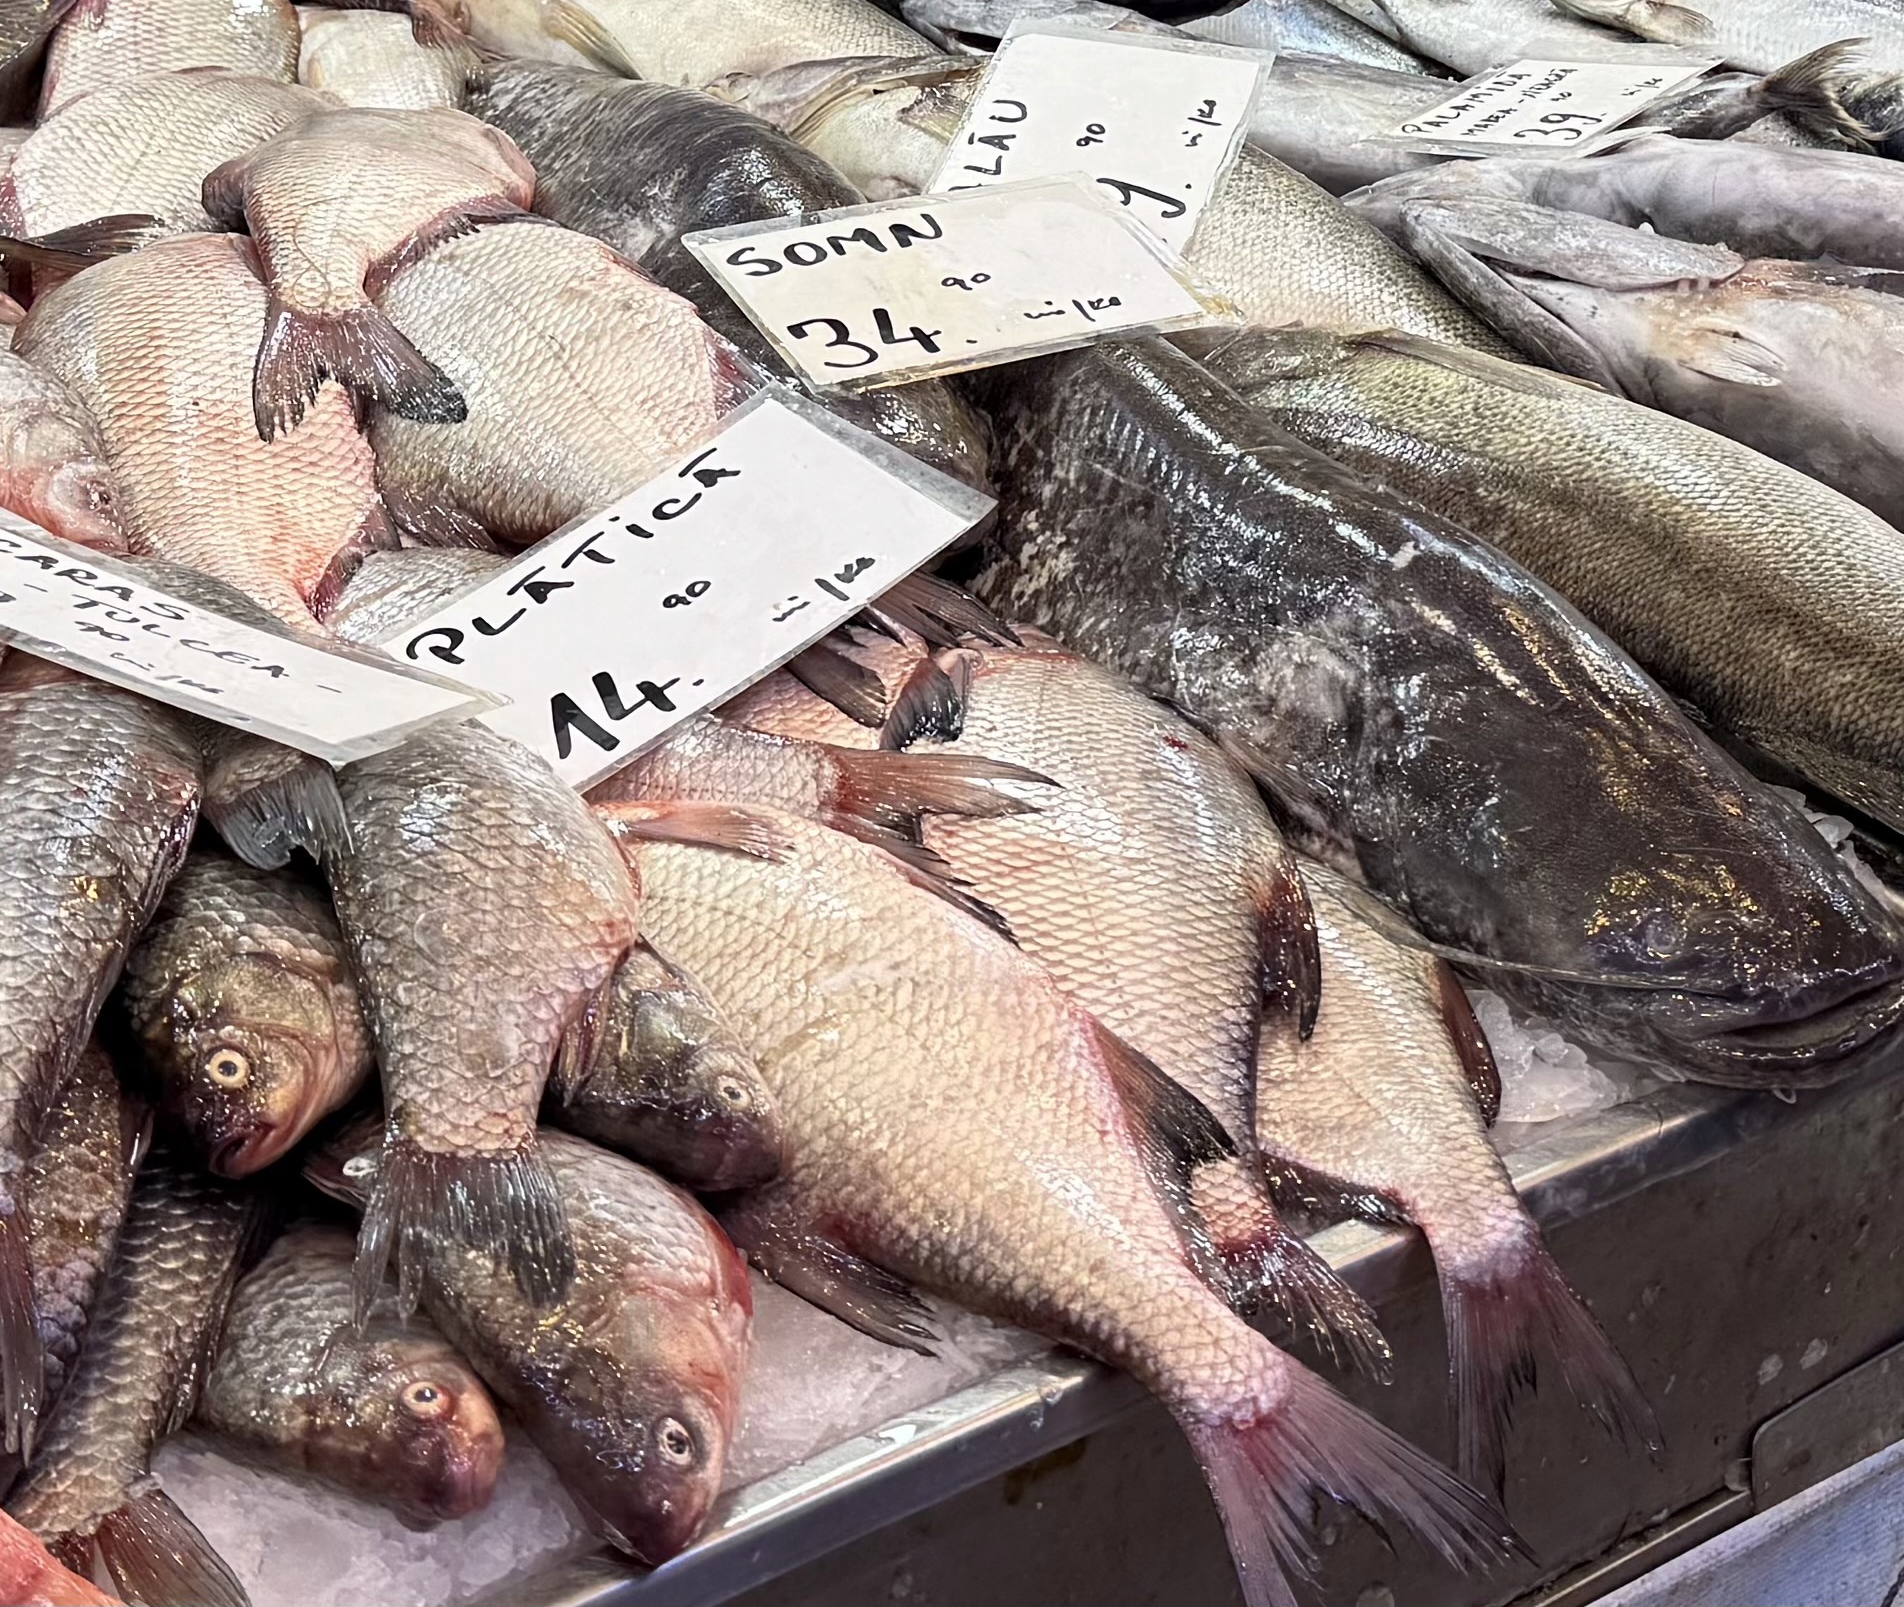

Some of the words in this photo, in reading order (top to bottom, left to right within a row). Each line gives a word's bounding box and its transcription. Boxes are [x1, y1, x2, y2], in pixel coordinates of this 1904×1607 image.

[1076, 122, 1107, 148] 90
[726, 212, 944, 278] SOMN
[941, 271, 992, 292] 90
[661, 580, 713, 609] 90
[74, 619, 131, 644] 90
